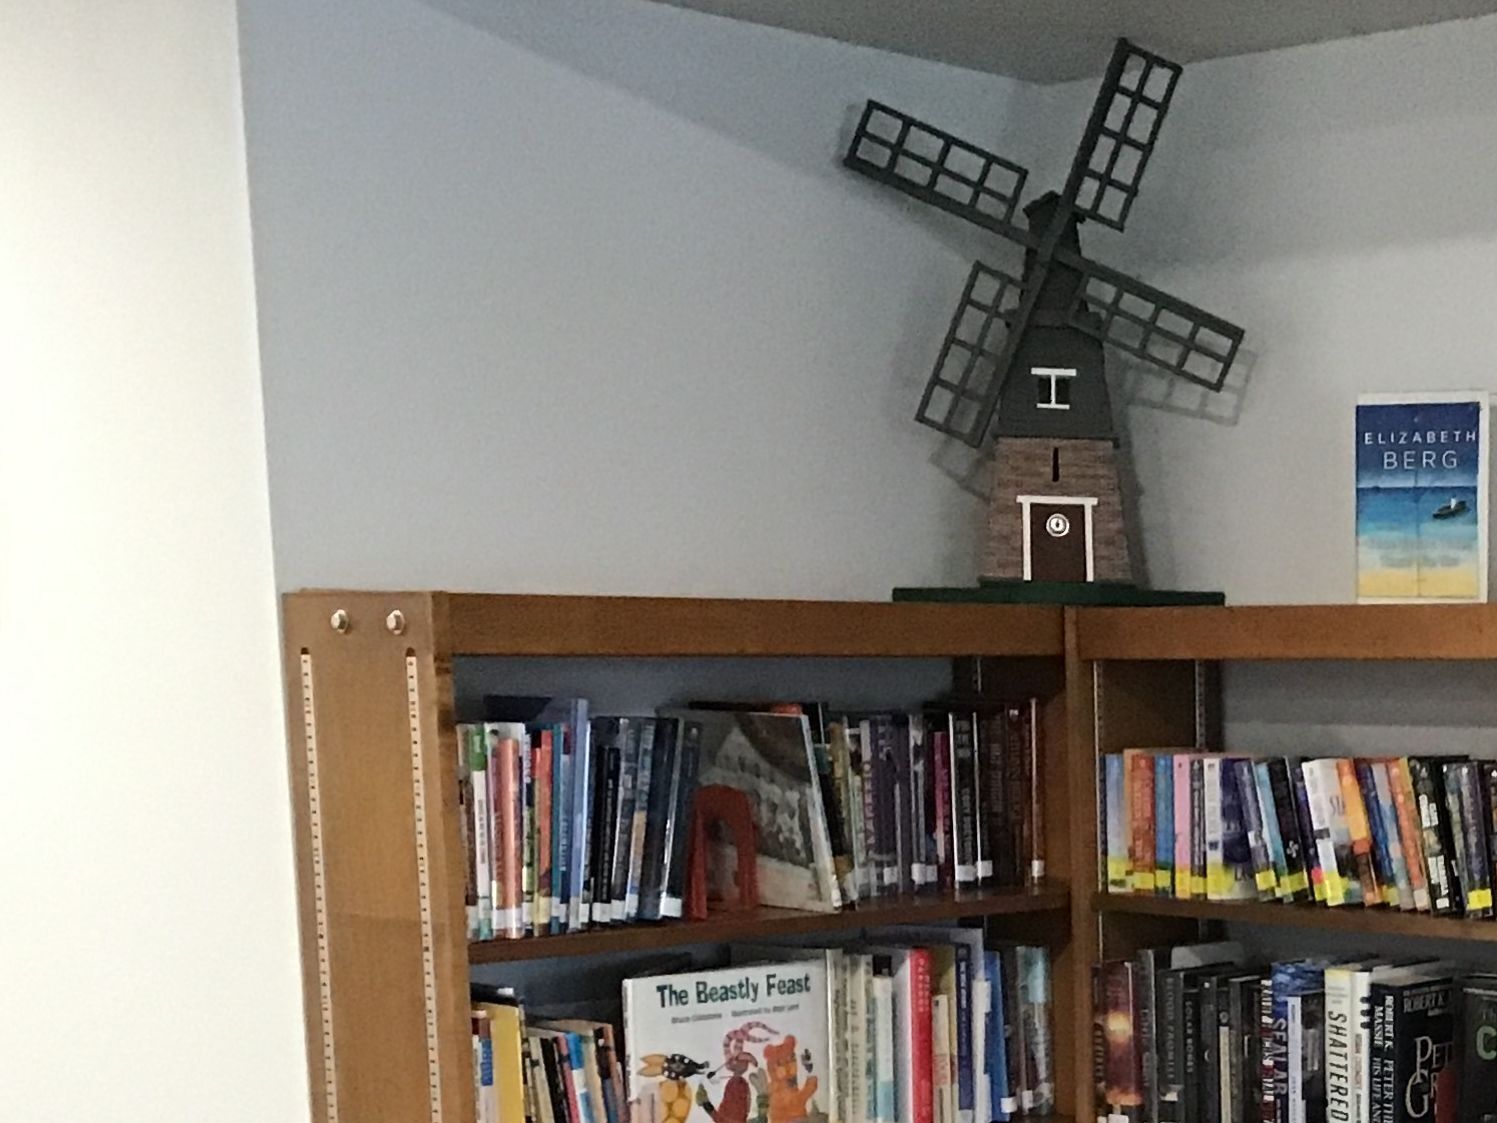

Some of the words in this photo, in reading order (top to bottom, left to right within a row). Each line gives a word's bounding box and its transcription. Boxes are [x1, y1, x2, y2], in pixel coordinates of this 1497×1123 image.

[1364, 431, 1477, 445] ELIZABETH
[1383, 450, 1458, 470] BERG
[656, 983, 688, 1008] The
[696, 976, 759, 1004] Beastly
[766, 972, 811, 997] Feast
[1374, 1006, 1383, 1047] MASSIE
[1384, 995, 1394, 1039] ROBERT
[1327, 1011, 1349, 1122] SHATTERED
[1382, 1060, 1394, 1101] PETER
